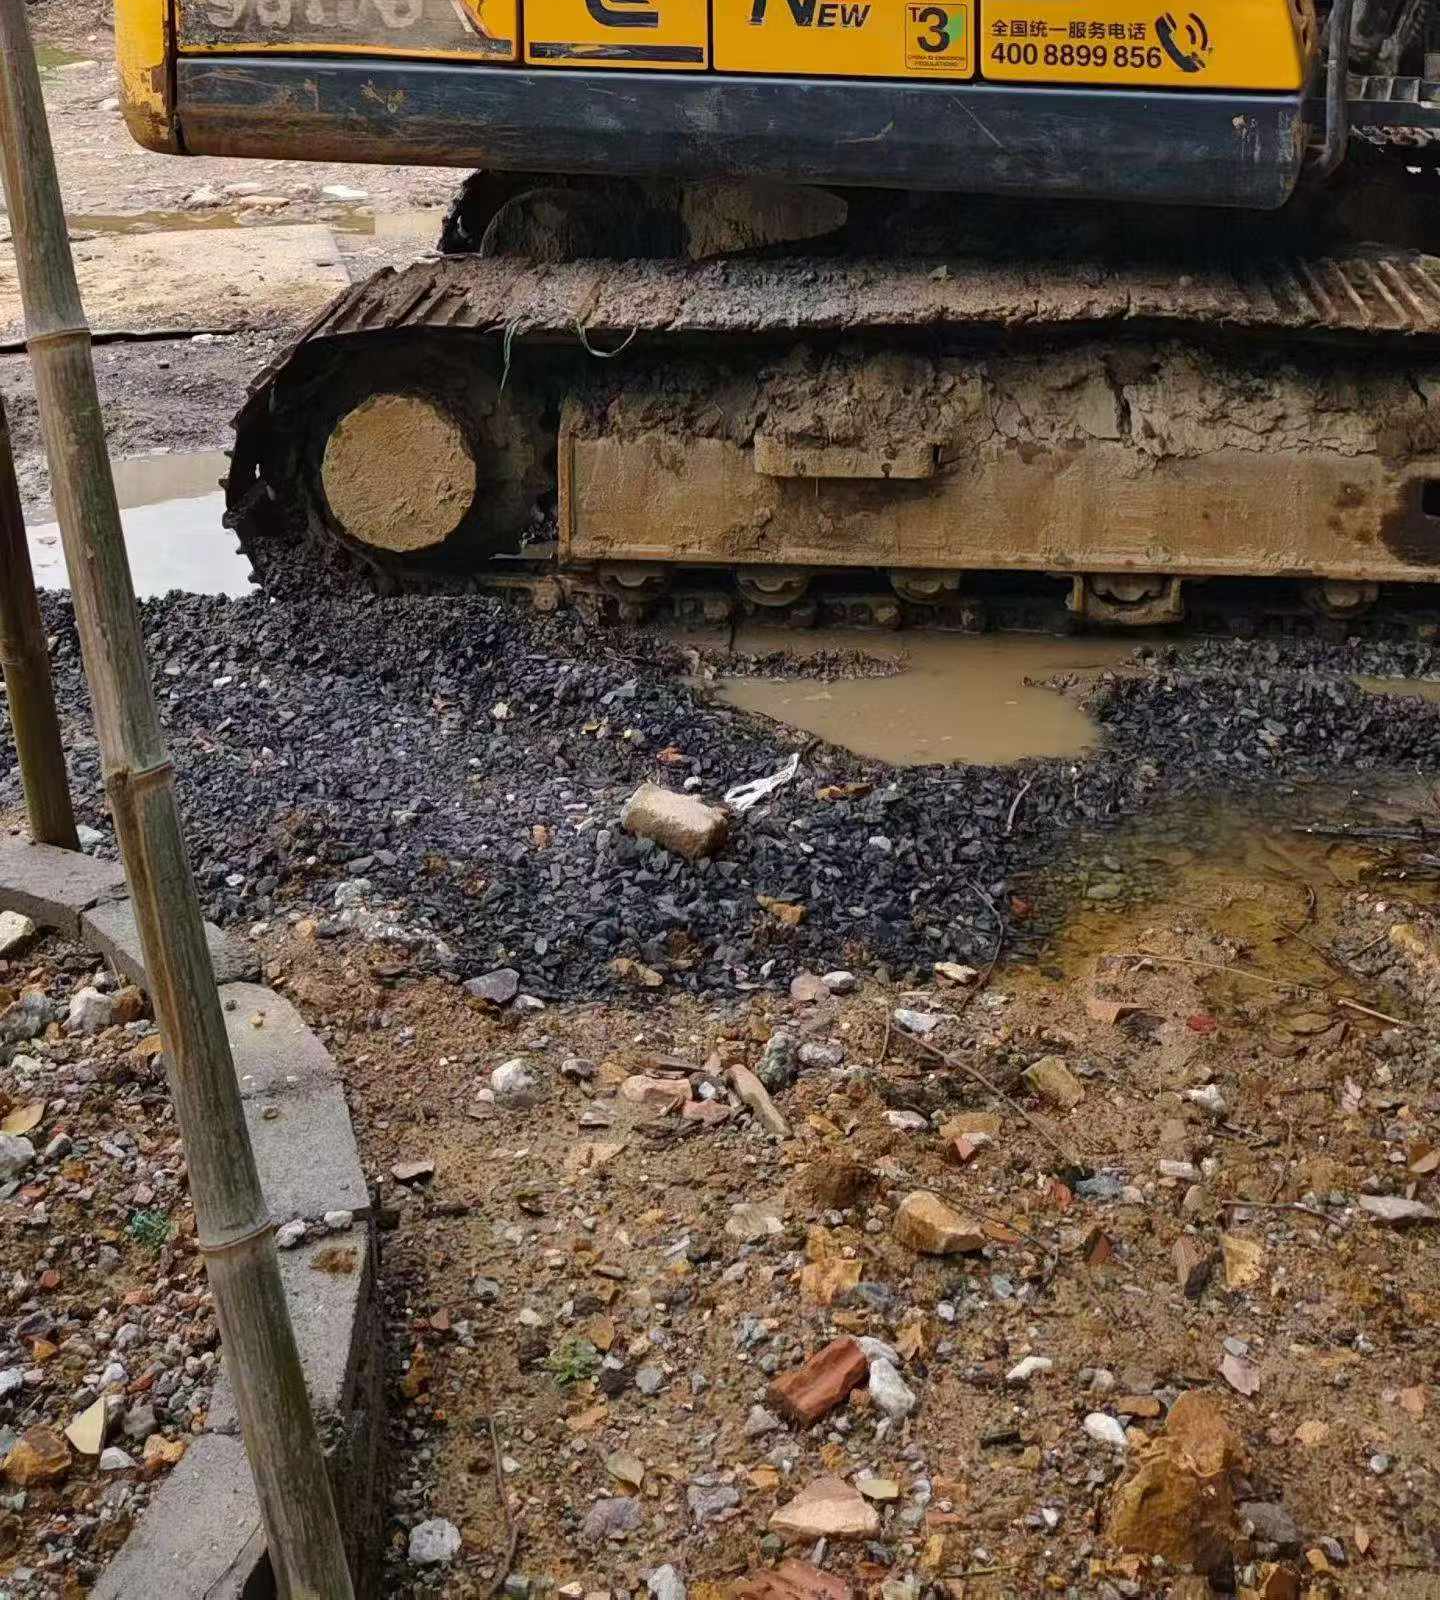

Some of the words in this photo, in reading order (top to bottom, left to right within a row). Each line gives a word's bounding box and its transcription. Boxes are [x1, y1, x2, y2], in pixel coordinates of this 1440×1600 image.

[991, 19, 1146, 41] 全国统一服务电话
[991, 42, 1038, 65] 400
[1043, 43, 1108, 67] 8899
[1113, 45, 1162, 69] 856
